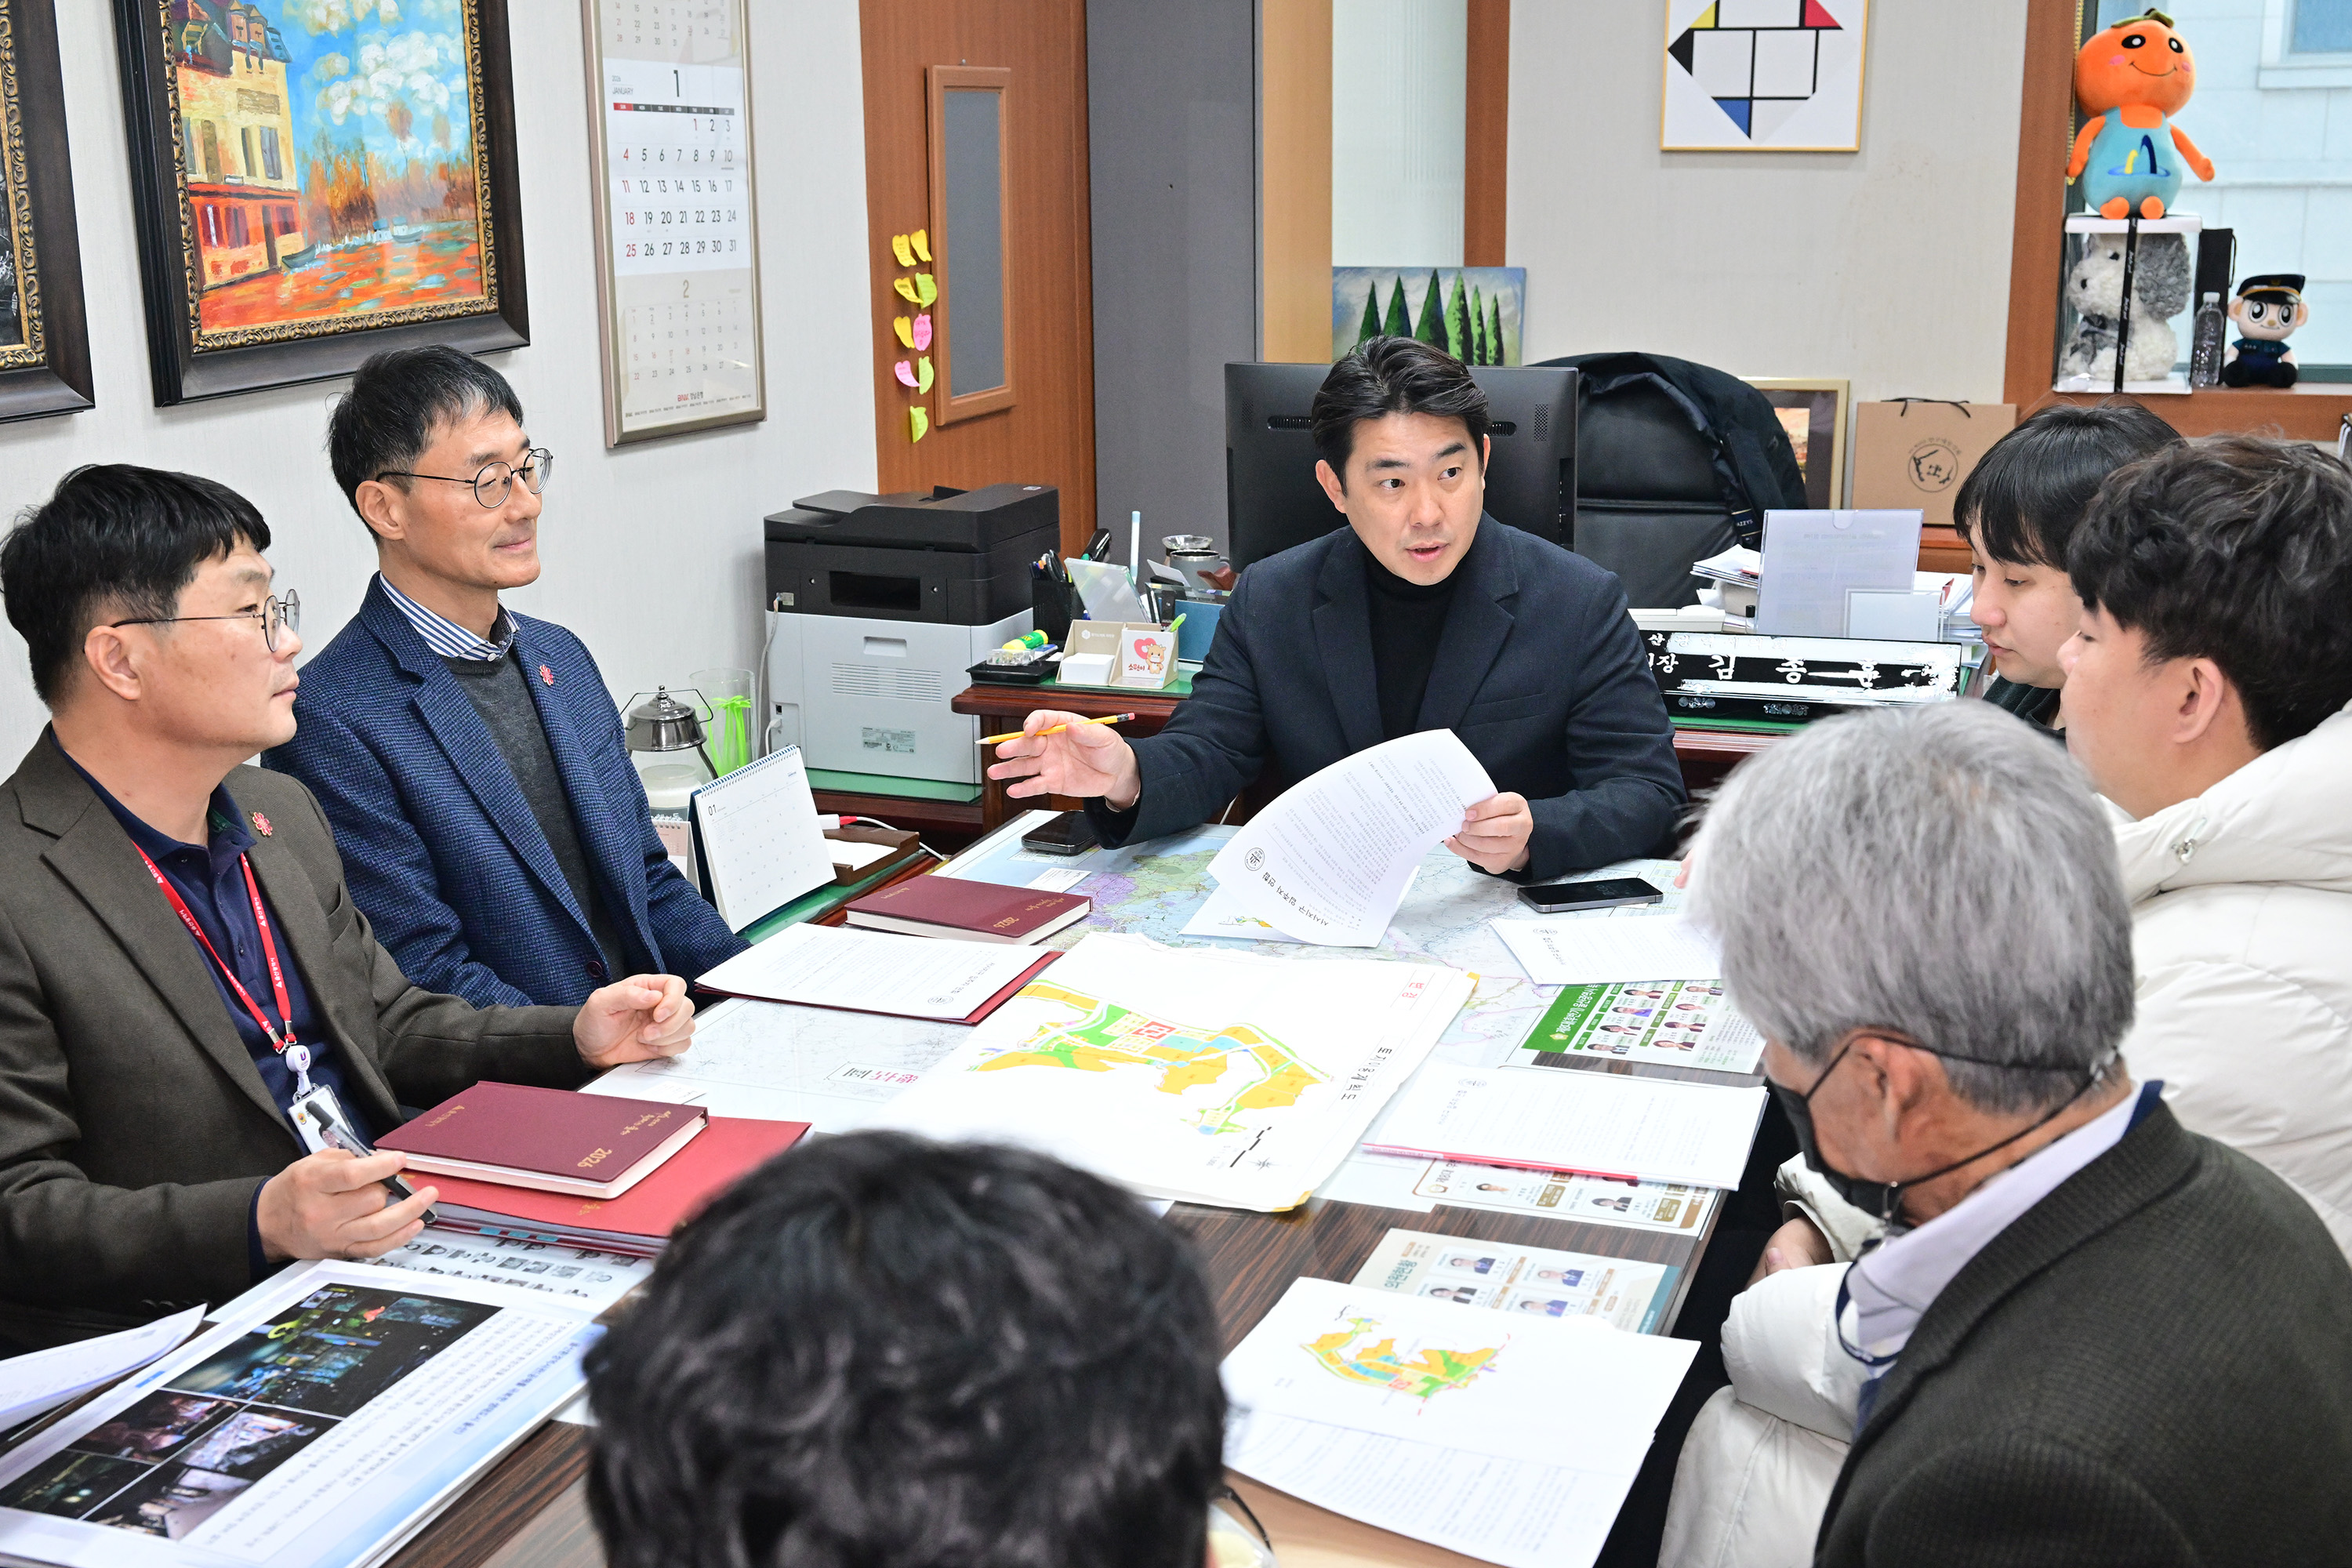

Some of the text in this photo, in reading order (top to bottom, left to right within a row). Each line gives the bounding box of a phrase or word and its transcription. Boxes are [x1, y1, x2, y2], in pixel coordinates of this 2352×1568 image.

[673, 70, 679, 97] 1
[612, 87, 634, 96] JANUARY
[694, 118, 730, 132] 1 2 3
[623, 148, 732, 162] 4 5 6 7 8 9 10
[622, 180, 731, 193] 11 12 13 14 15 16 17
[626, 210, 736, 225] 18 19 20 21 22 23 24
[626, 240, 736, 257] 25 26 27 28 29 30 31
[683, 280, 689, 298] 2
[709, 804, 717, 815] 01
[1262, 872, 1276, 887] 연합
[1276, 886, 1297, 906] 입주자
[993, 916, 1019, 928] 2026
[577, 1148, 612, 1167] 2026
